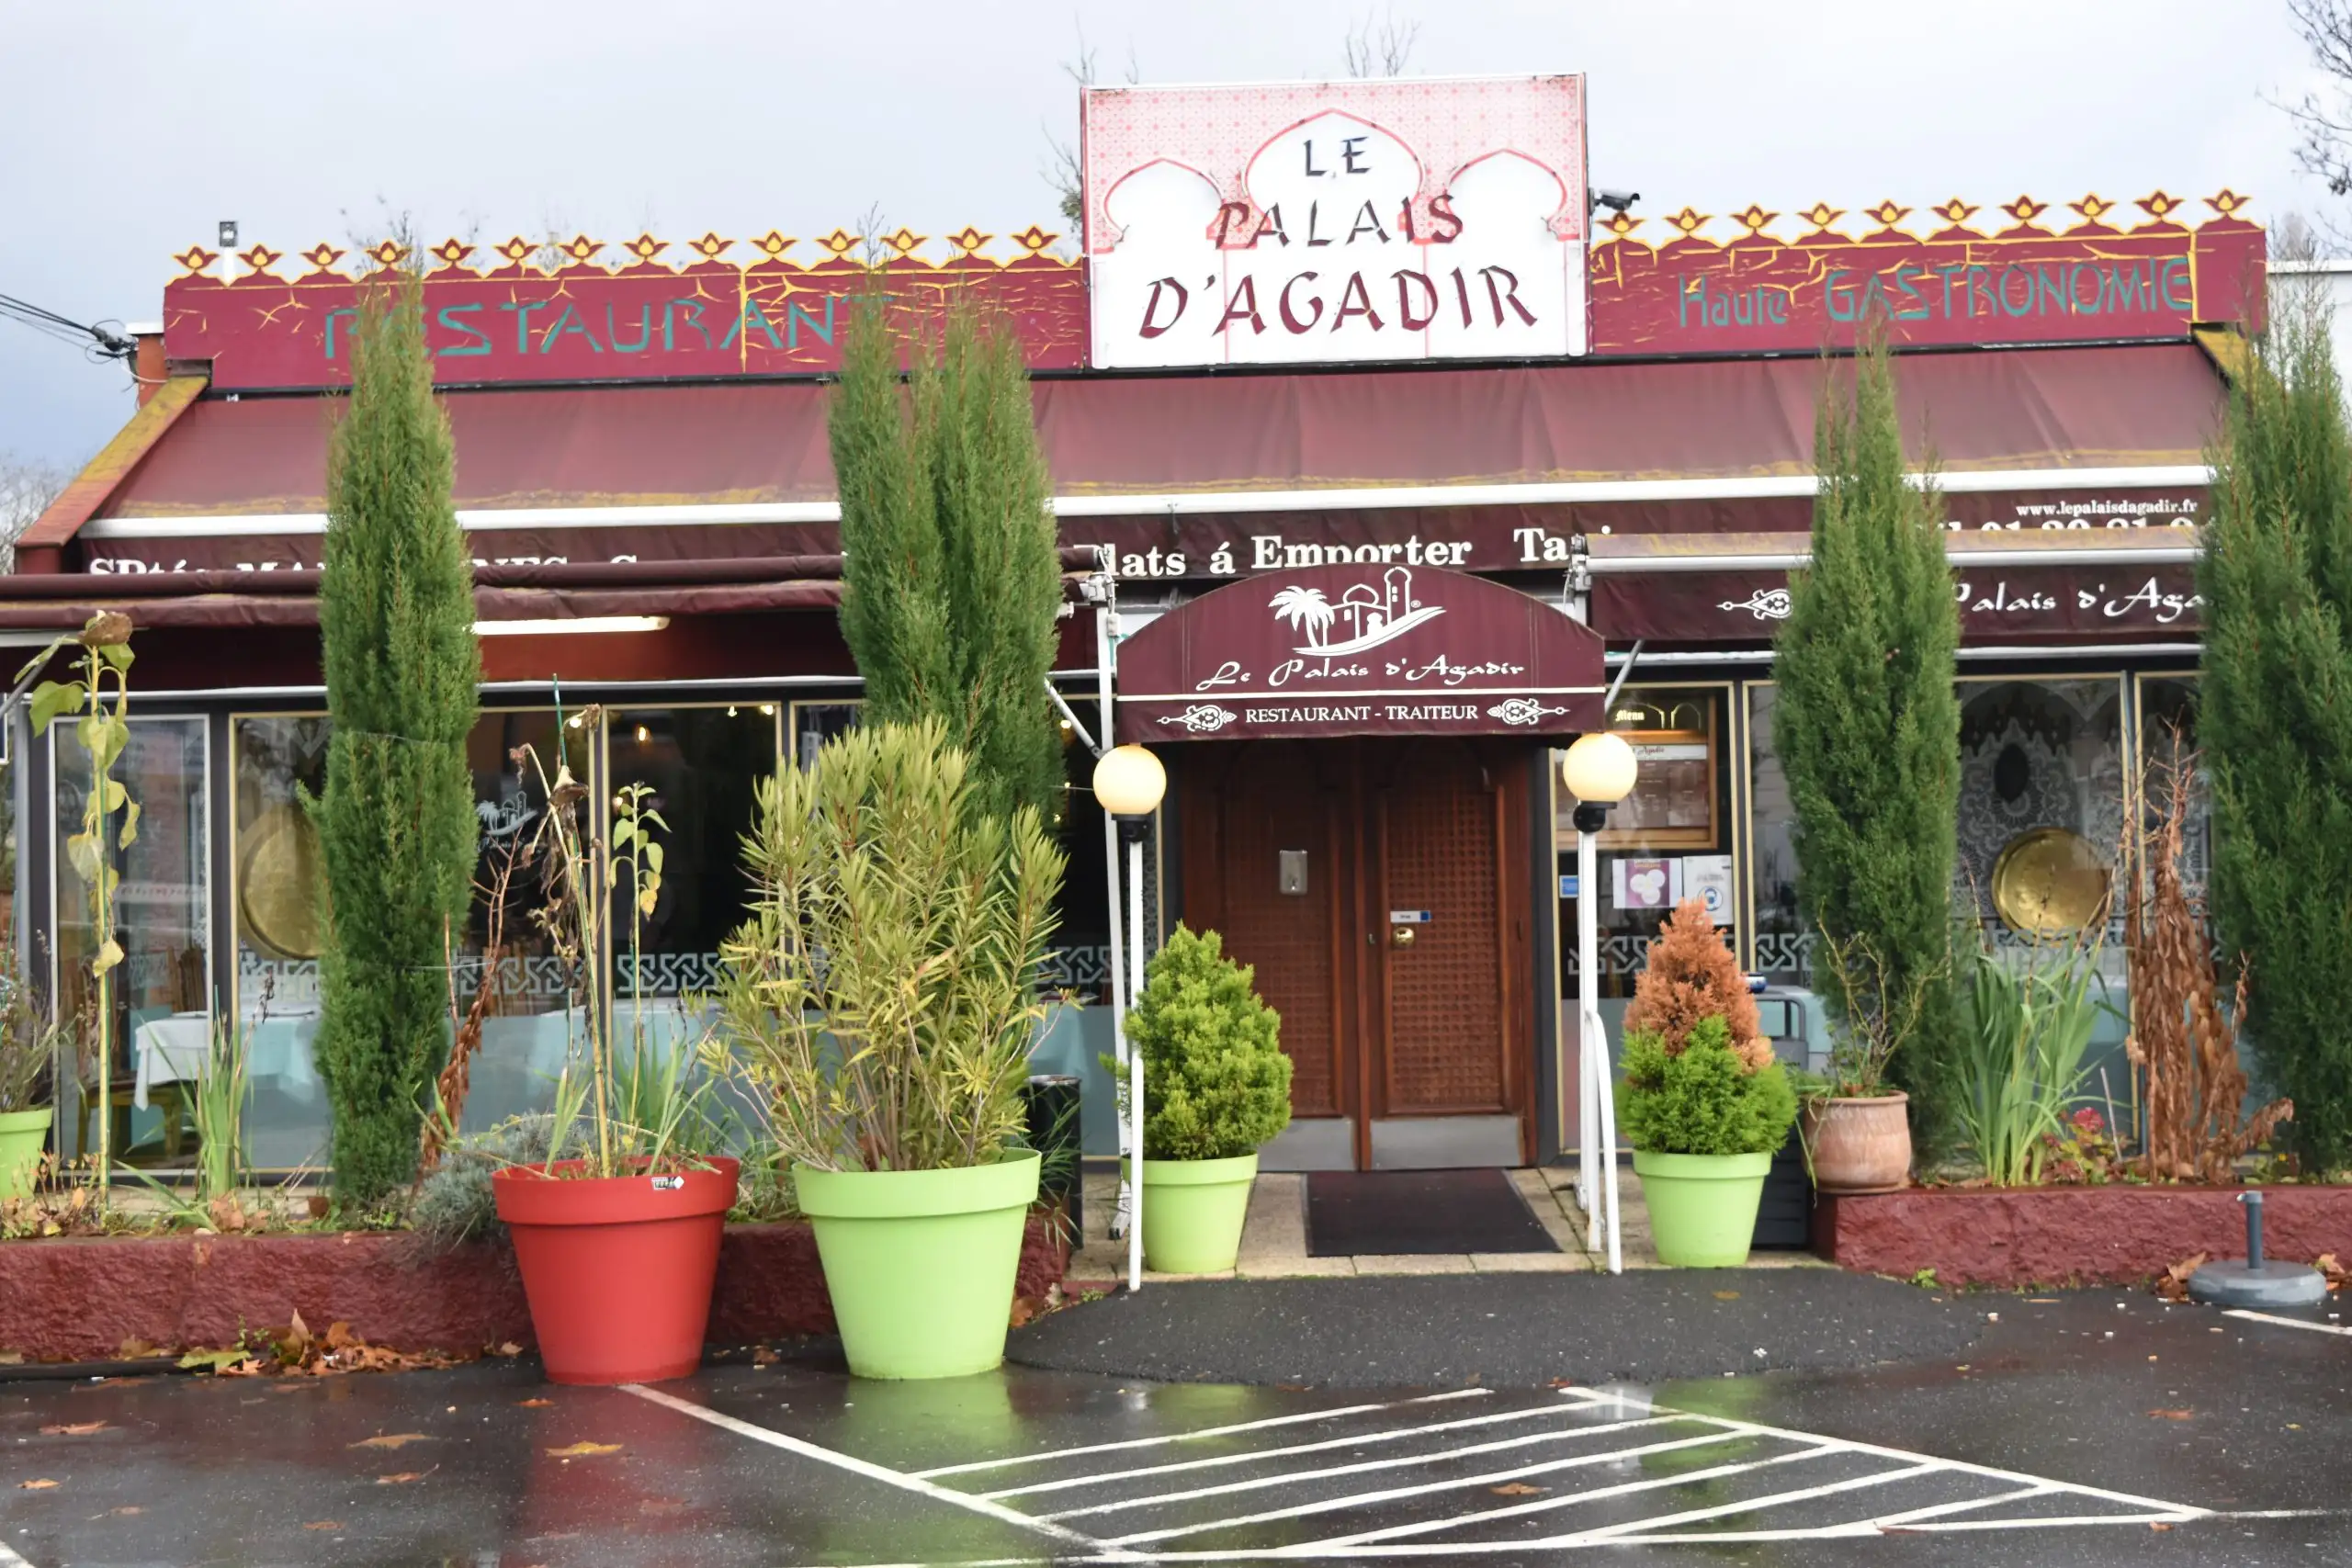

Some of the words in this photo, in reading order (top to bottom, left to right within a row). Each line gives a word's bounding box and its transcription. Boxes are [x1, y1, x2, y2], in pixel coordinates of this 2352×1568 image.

[1304, 136, 1372, 177] LE
[1216, 193, 1464, 250] PALAIS
[1138, 264, 1538, 339] D'AGADIR
[1824, 254, 2193, 322] GASTRONOMIE
[325, 294, 894, 359] RSTAURAN
[2016, 499, 2198, 518] www.lepalaisdagadir.fr
[1073, 543, 1187, 577] lats
[1195, 660, 1250, 691] Le
[1268, 657, 1369, 687] Palais
[1385, 653, 1525, 686] d'Agadir
[1245, 705, 1371, 724] RESTAURANT
[1385, 705, 1478, 721] TRAITEUR
